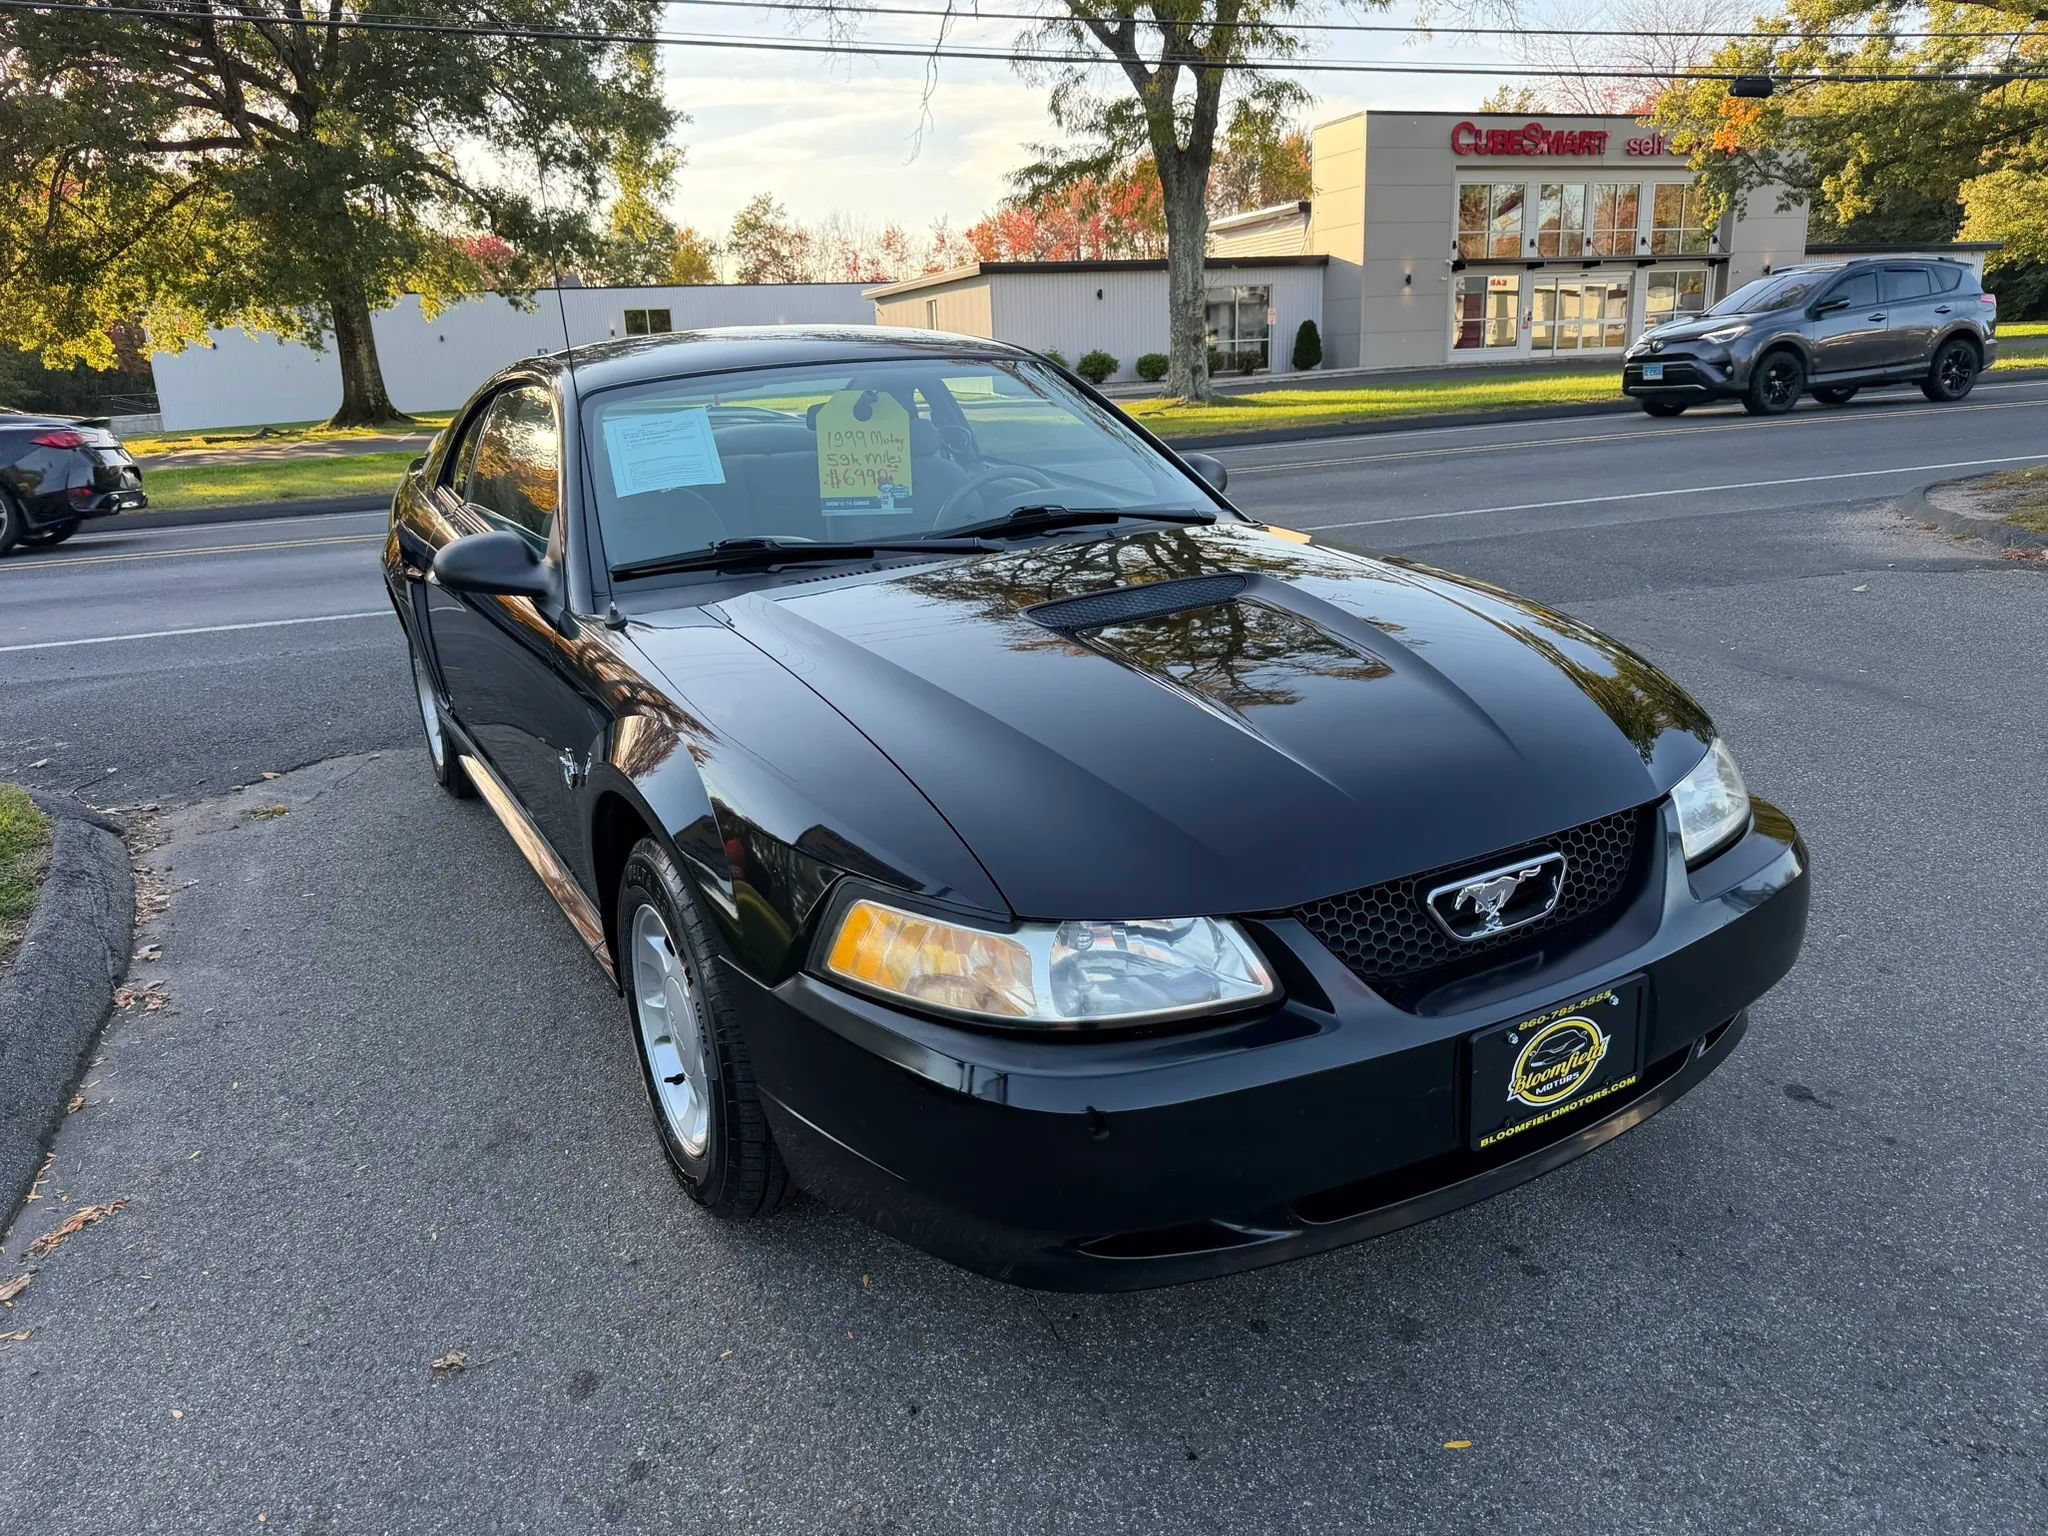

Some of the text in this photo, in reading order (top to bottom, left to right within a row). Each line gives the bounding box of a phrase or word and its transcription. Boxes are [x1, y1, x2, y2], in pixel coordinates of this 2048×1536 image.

[825, 452, 861, 467] 59k
[827, 430, 867, 449] 1999
[695, 1001, 711, 1057] ULTRA
[1518, 990, 1613, 1031] 860-785-5555
[1512, 1041, 1606, 1095] Bloomfield
[1535, 1071, 1580, 1095] MOTORS
[1480, 1075, 1637, 1148] BLOOMFIELDMOTORS.COM
